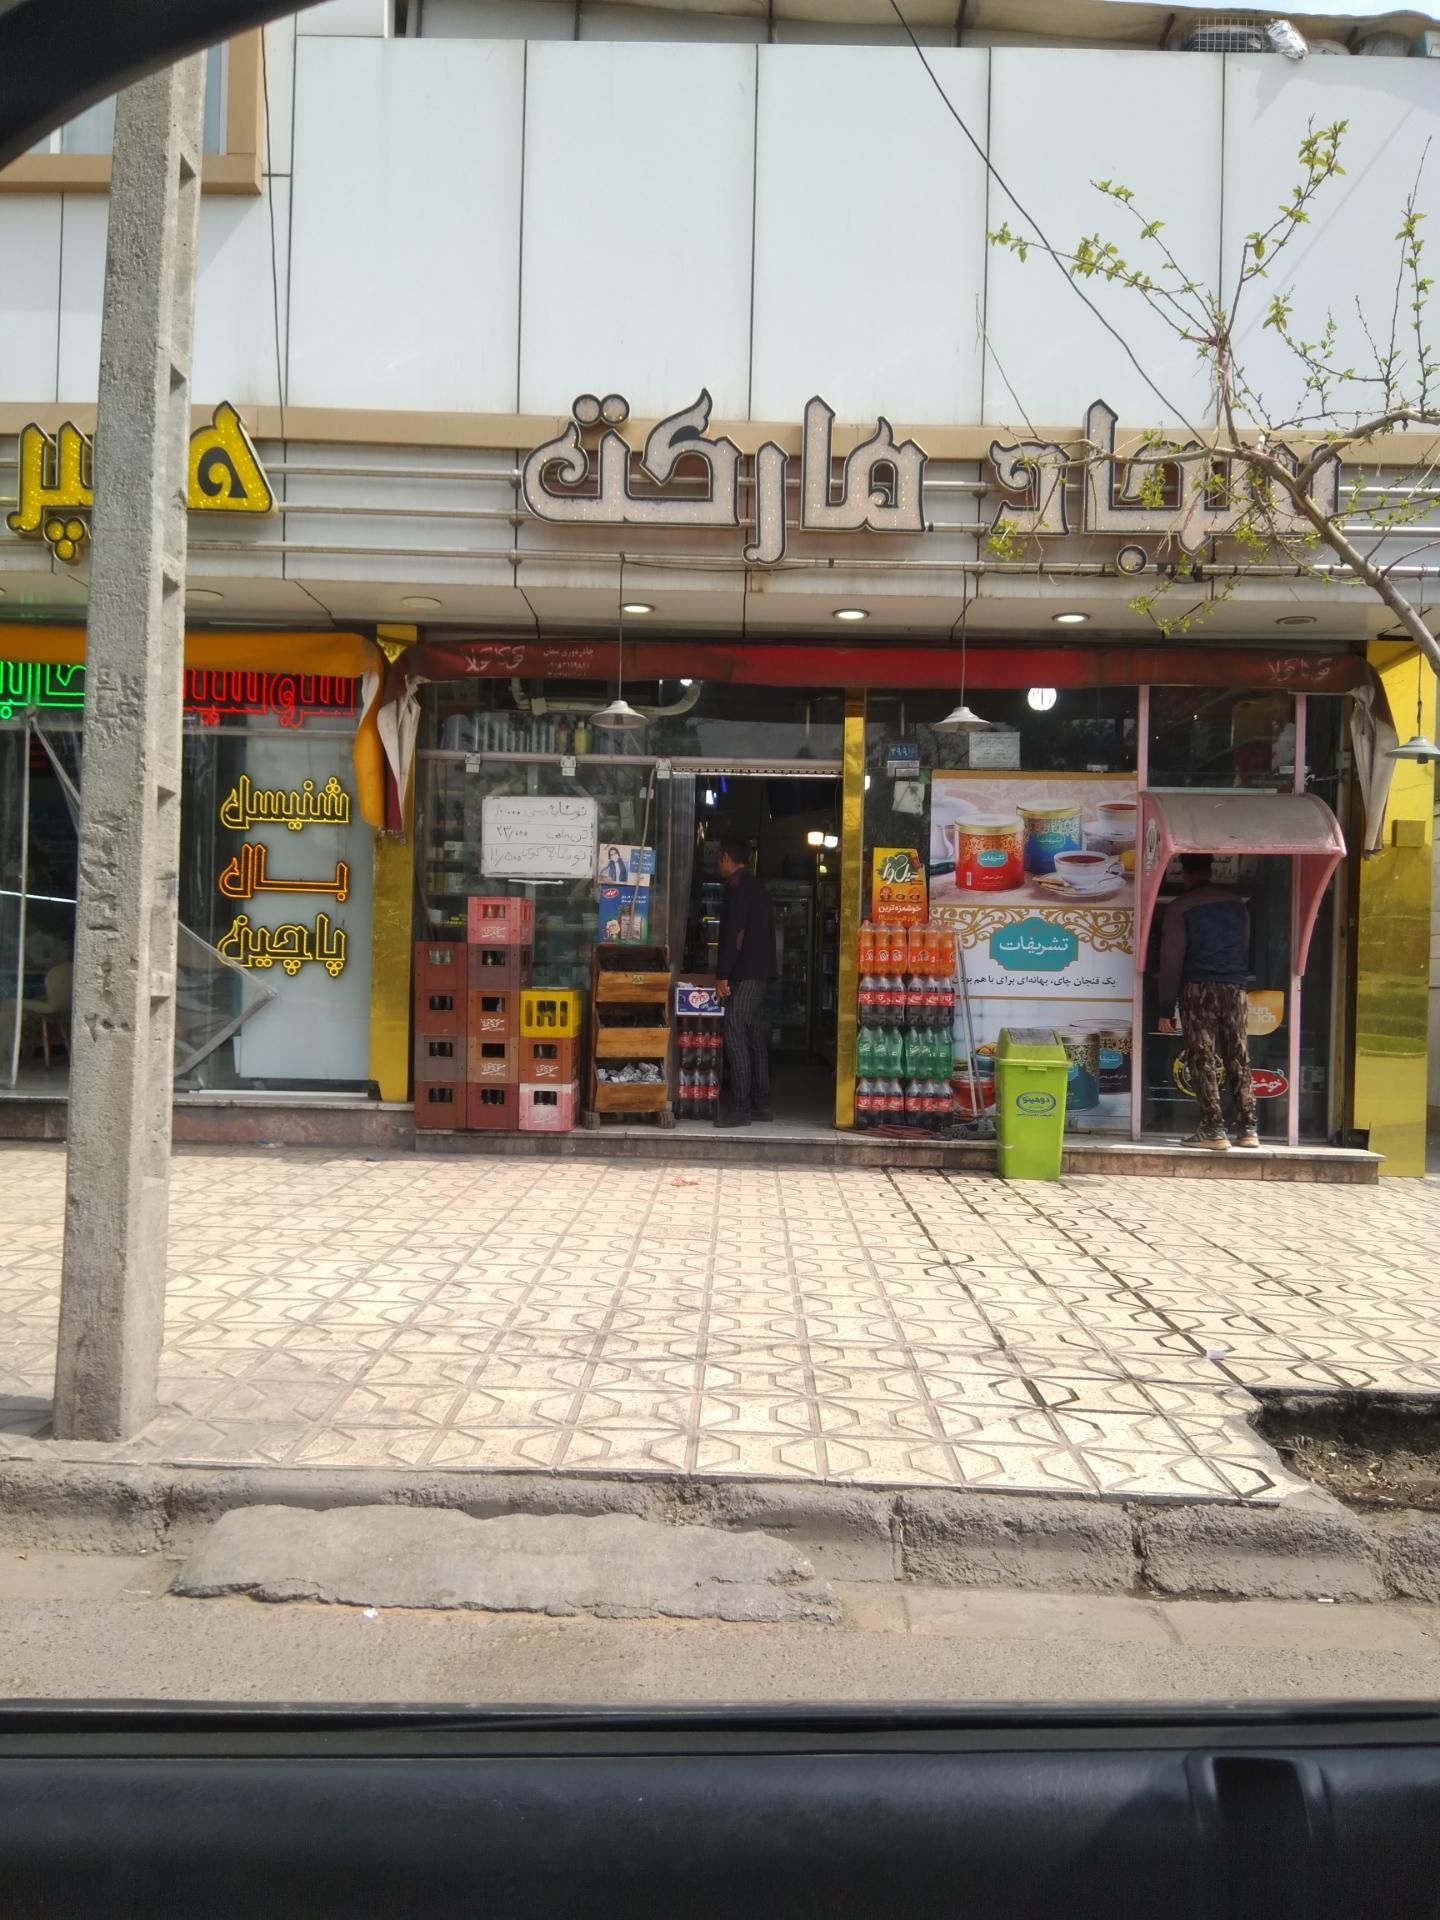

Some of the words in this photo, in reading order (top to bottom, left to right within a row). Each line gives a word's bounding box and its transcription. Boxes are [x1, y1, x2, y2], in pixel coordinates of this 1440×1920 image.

[521, 388, 928, 566] مارکت
[220, 775, 349, 830] شنیسل
[219, 843, 348, 901] بال
[217, 914, 346, 976] پاچین
[1000, 936, 1069, 955] تشریفات
[974, 976, 987, 985] هم
[996, 975, 1015, 986] برای
[1073, 976, 1100, 987] فنجان
[1102, 976, 1116, 988] یک
